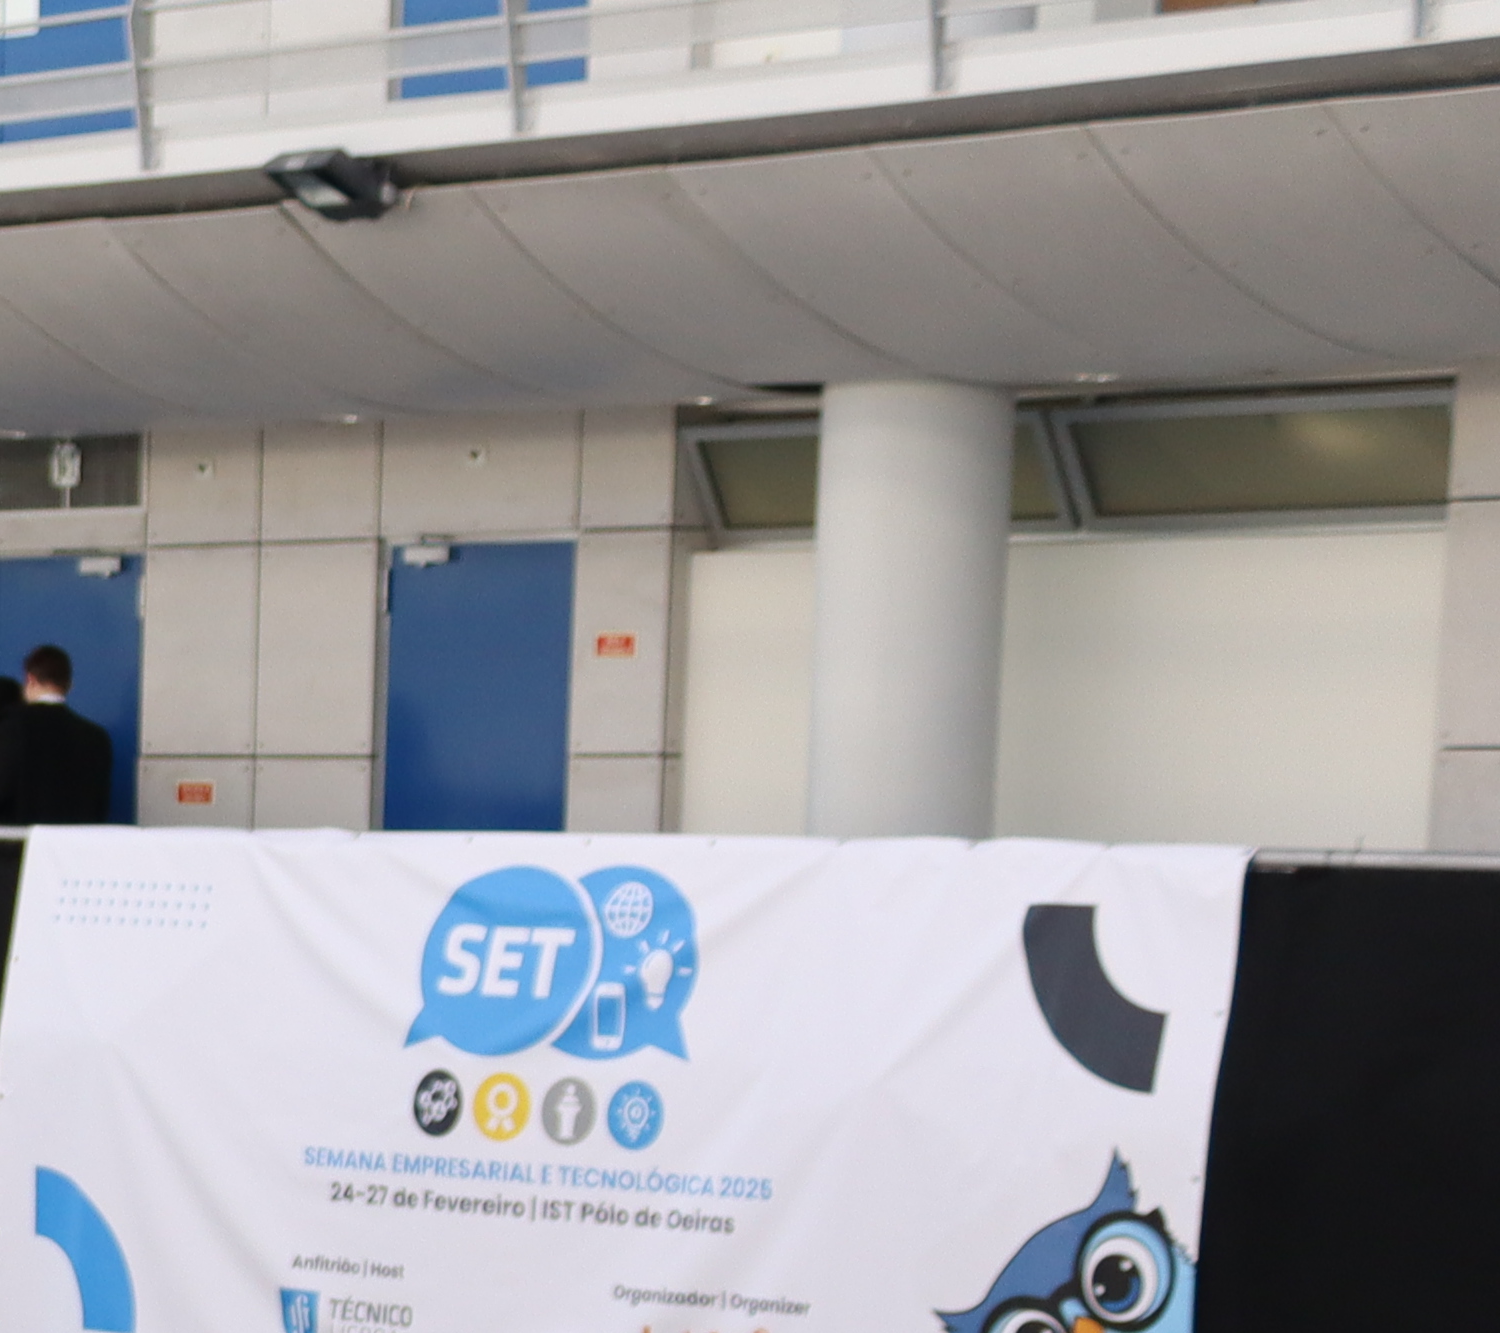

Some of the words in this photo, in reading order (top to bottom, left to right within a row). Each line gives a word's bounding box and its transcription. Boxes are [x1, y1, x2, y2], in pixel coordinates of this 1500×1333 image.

[436, 922, 575, 1000] SET
[304, 1146, 387, 1172] SEMANA
[392, 1154, 533, 1184] EMPRESARIAL
[541, 1164, 552, 1185] E
[559, 1165, 715, 1198] TECNOLÓGICA
[329, 1181, 389, 1205] 24-27
[392, 1187, 419, 1208] de
[423, 1190, 525, 1218] Fevereiro
[541, 1199, 574, 1222] IST
[580, 1200, 630, 1228] Pólo
[634, 1206, 662, 1228] de
[666, 1207, 735, 1235] Oeiras
[370, 1262, 405, 1279] Host
[329, 1295, 413, 1328] TÉCNICO
[614, 1284, 716, 1306] Organizador
[730, 1293, 811, 1316] Organizer
